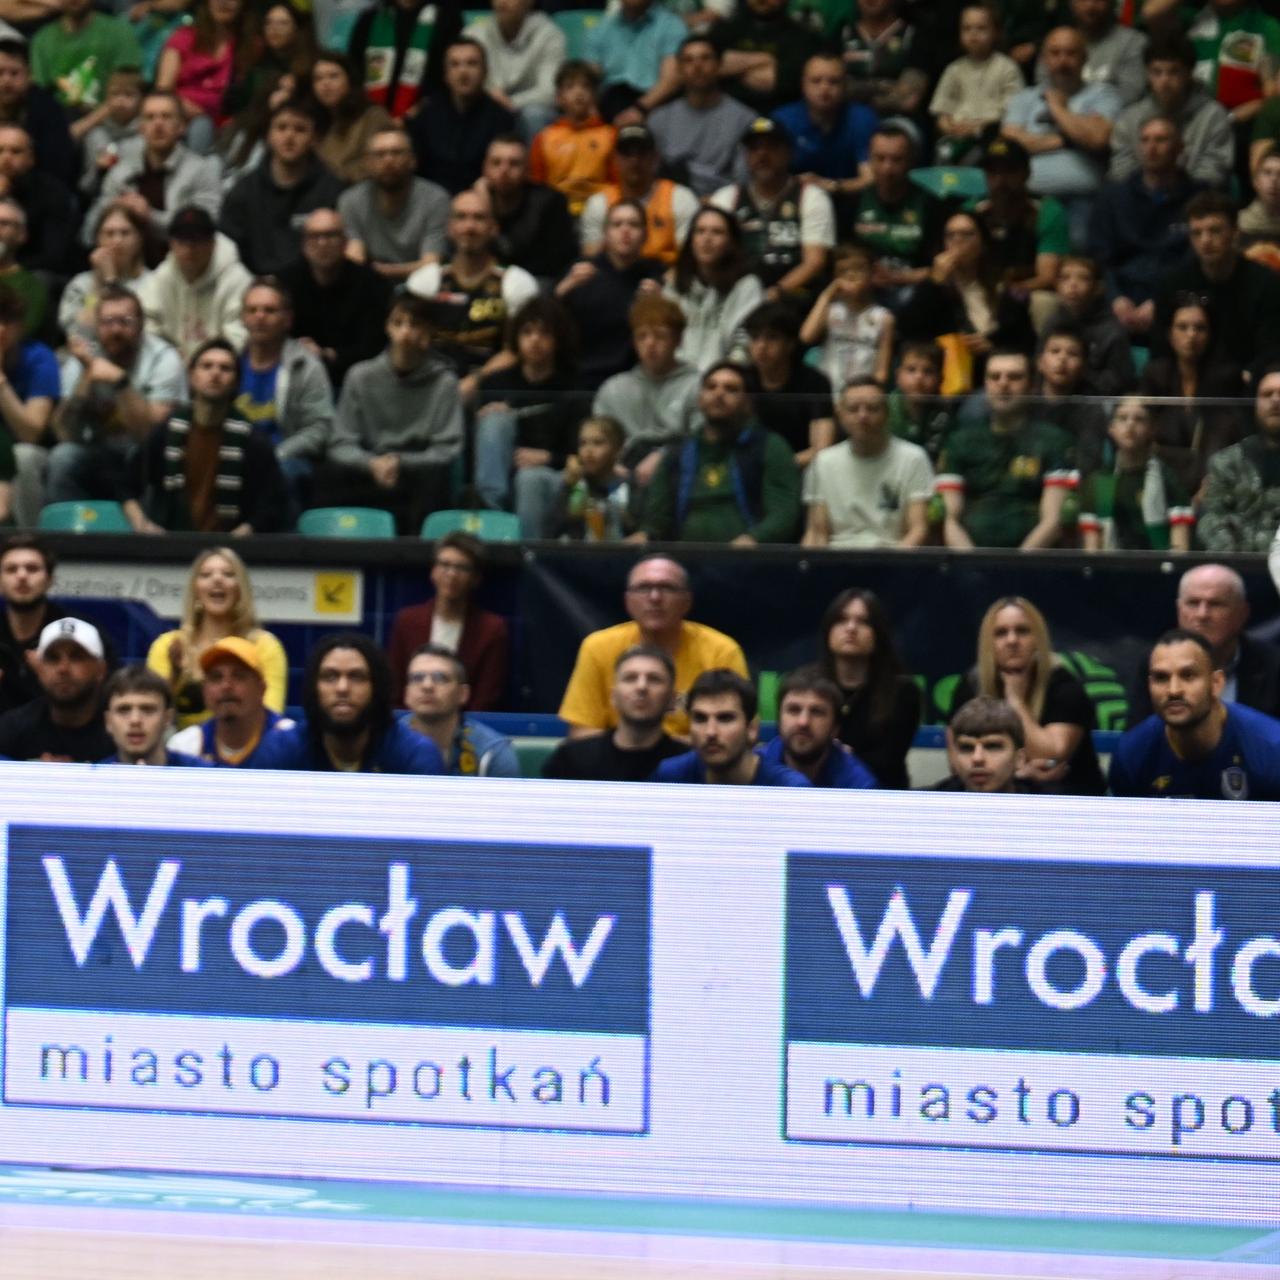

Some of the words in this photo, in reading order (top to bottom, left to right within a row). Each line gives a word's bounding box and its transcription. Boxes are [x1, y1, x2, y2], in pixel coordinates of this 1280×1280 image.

[42, 855, 618, 988] Wrocław
[40, 1035, 281, 1091] miasto
[321, 1046, 612, 1109] spotkań
[823, 1069, 1081, 1128] miasto
